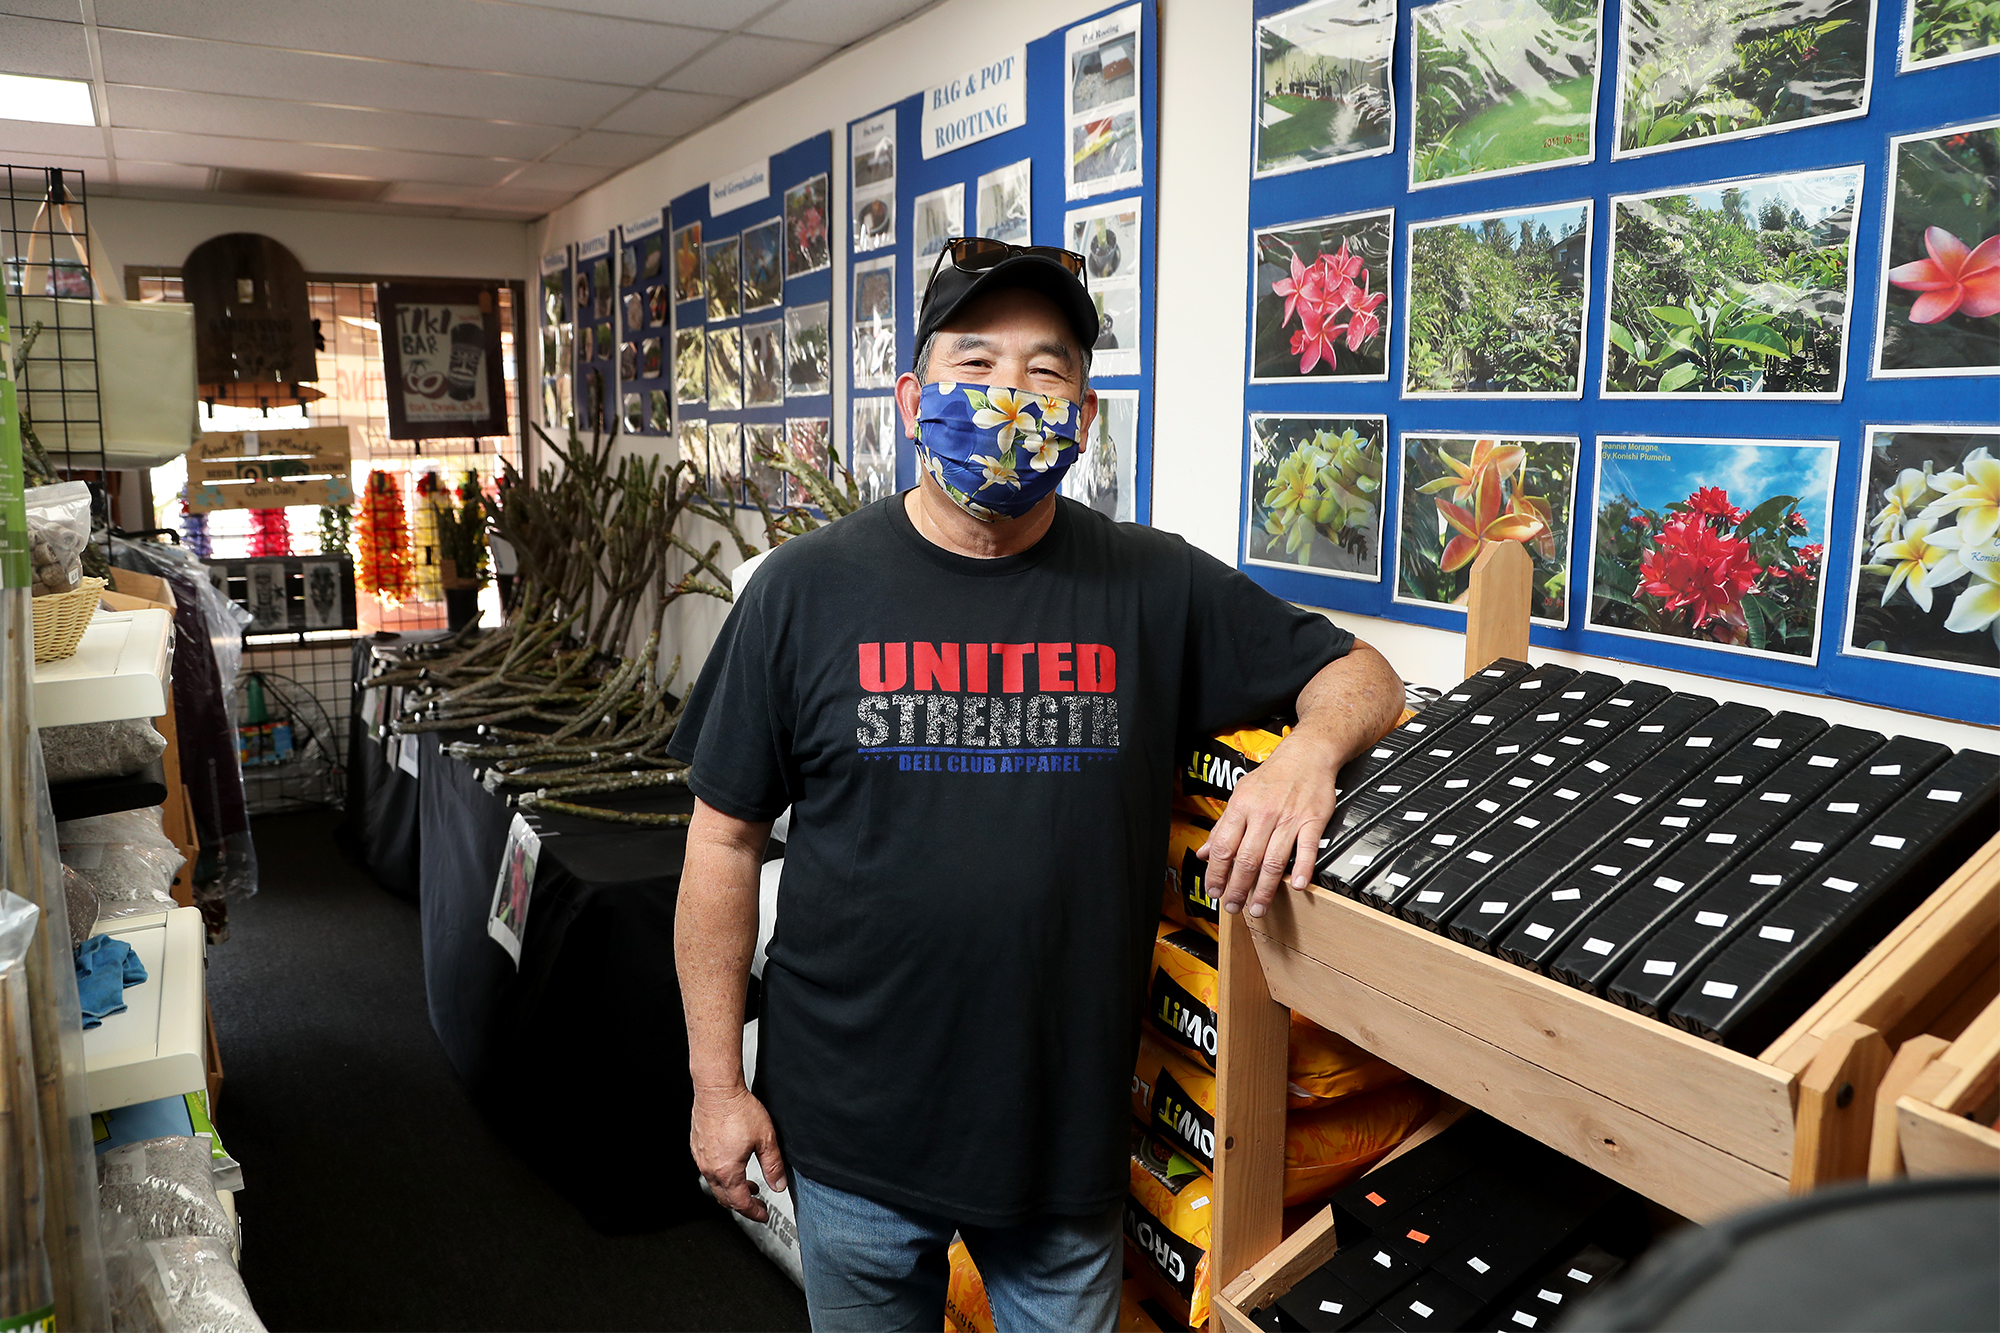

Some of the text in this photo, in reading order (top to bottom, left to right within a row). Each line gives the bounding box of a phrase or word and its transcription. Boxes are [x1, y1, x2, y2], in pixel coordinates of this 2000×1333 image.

[932, 55, 1015, 111] BAG & POT
[935, 102, 1008, 149] ROOTING
[397, 307, 451, 334] TIKI
[402, 334, 438, 355] BAR
[1602, 452, 1671, 461] By Konishi Plumeria
[1628, 443, 1659, 452] Moragne
[244, 485, 297, 497] Open Daily
[858, 641, 1117, 693] UNITED
[856, 694, 1120, 747] STRENGTH
[899, 754, 1081, 773] BELL CLUB APPAREL
